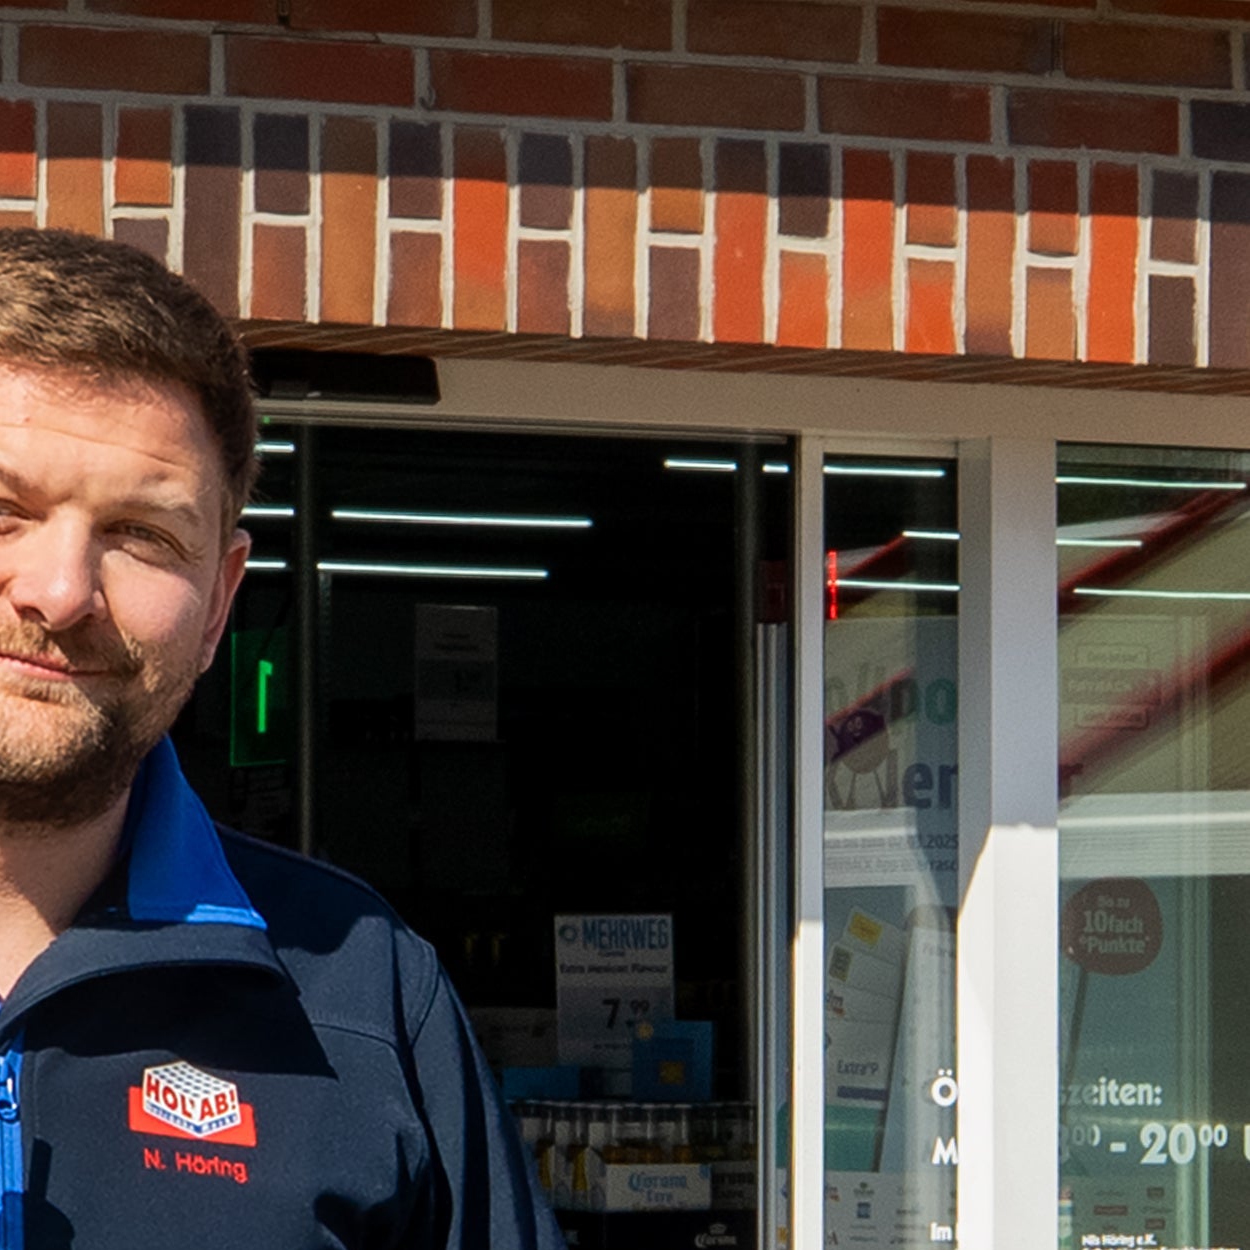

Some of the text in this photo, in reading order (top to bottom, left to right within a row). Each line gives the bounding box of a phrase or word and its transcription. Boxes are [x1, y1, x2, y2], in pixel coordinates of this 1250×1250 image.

[1083, 909, 1144, 934] 10fach
[582, 919, 669, 949] MEHRWEG
[146, 1073, 237, 1121] HOL'AB!
[144, 1148, 166, 1170] N.
[628, 1172, 687, 1192] Corona
[694, 1233, 738, 1249] Corona
